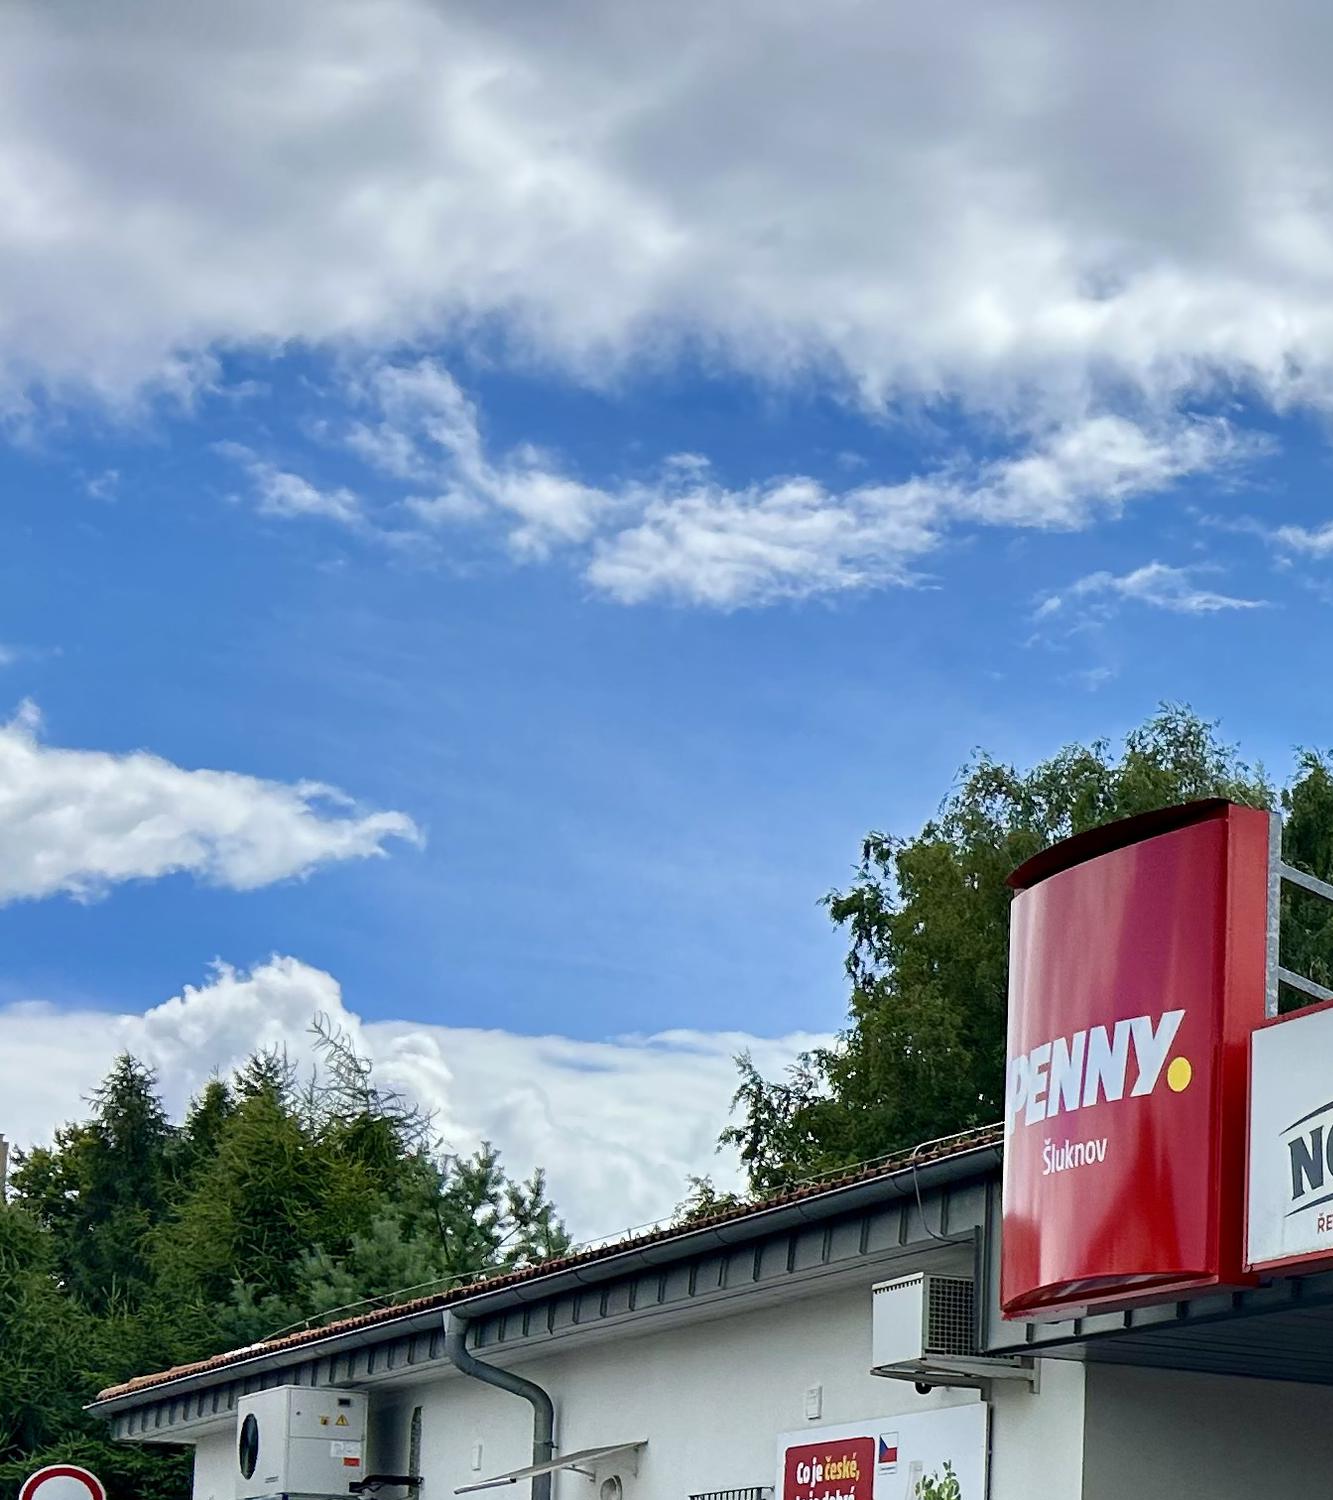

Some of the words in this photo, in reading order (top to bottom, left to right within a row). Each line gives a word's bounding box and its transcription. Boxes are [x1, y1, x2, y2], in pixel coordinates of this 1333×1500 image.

[1043, 1138, 1108, 1175] Šluknov
[796, 1462, 810, 1485] Co
[811, 1456, 823, 1488] je
[824, 1452, 860, 1481] české,
